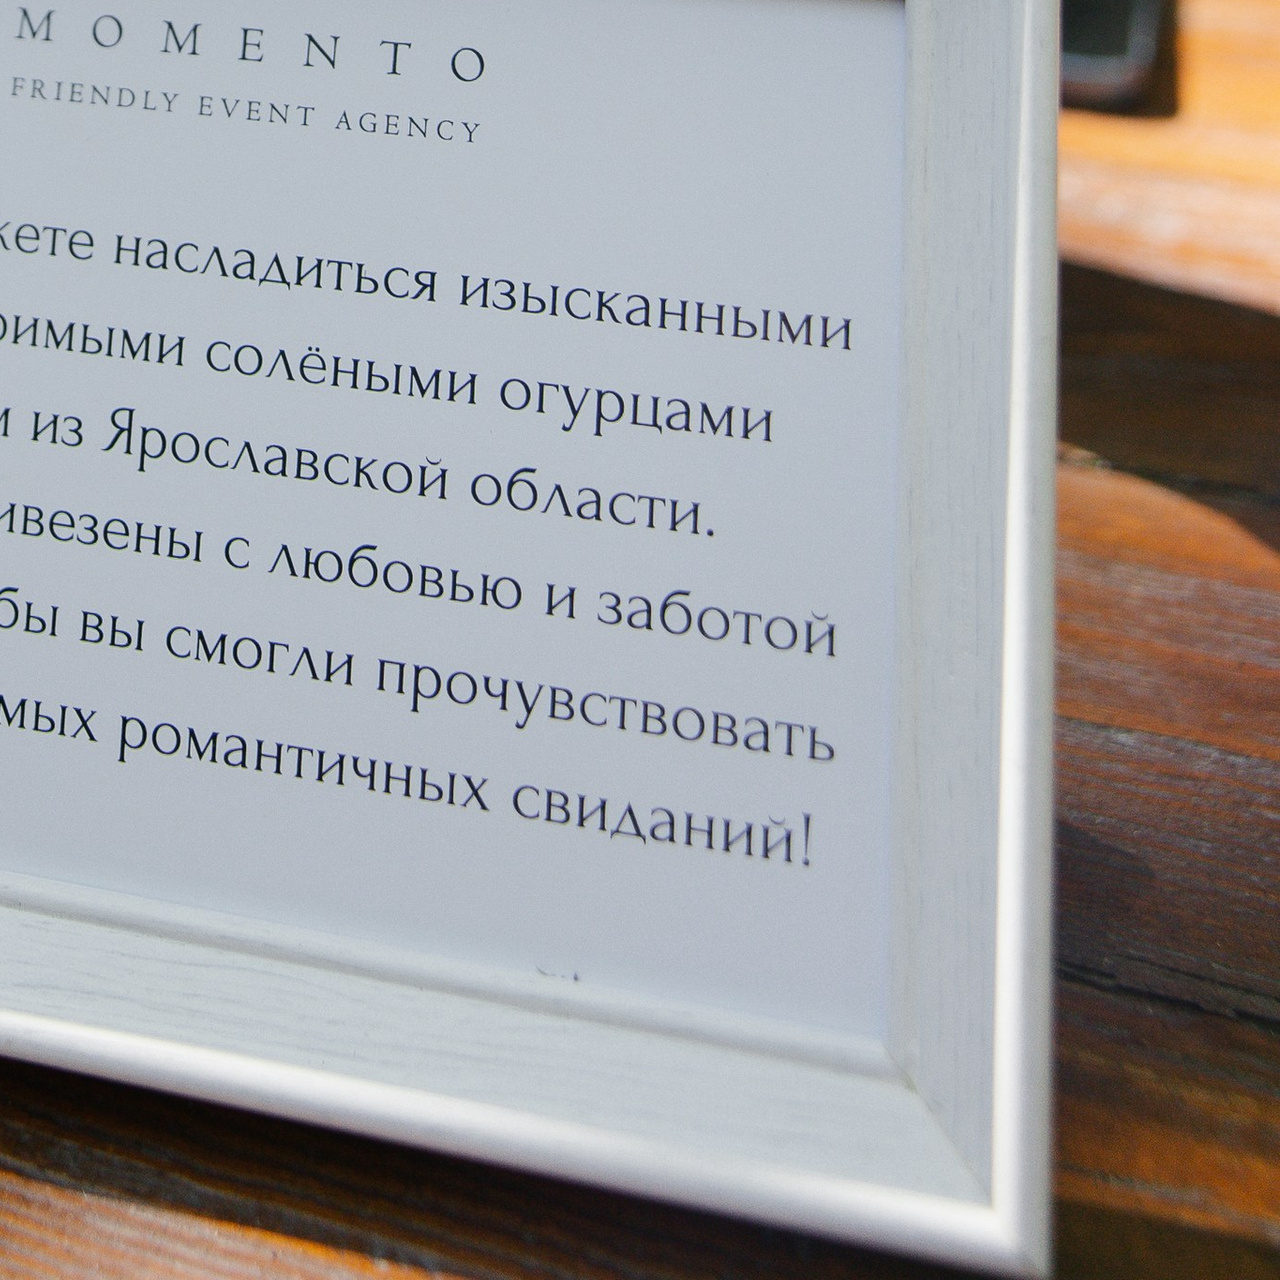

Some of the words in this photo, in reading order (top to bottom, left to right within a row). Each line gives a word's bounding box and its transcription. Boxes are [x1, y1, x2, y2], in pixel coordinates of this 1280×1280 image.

[16, 7, 484, 82] MOMENTO
[11, 77, 179, 112] FRIENDLY
[199, 96, 315, 126] EVENT
[335, 110, 480, 143] AGENCY
[114, 235, 437, 302] насладиться
[460, 275, 851, 350] изысканными
[206, 341, 477, 405] солёными
[500, 378, 773, 442] огурцами
[31, 411, 83, 447] из
[101, 407, 448, 500] Ярославской
[471, 467, 714, 537] области.
[224, 537, 249, 569] с
[268, 544, 522, 610] любовью
[545, 583, 576, 619] и
[597, 590, 835, 657] заботой
[79, 610, 145, 651] вы
[166, 626, 354, 686] смогли
[377, 659, 834, 761] прочувствовать
[118, 715, 490, 812] романтичных
[513, 785, 811, 867] свиданий!
